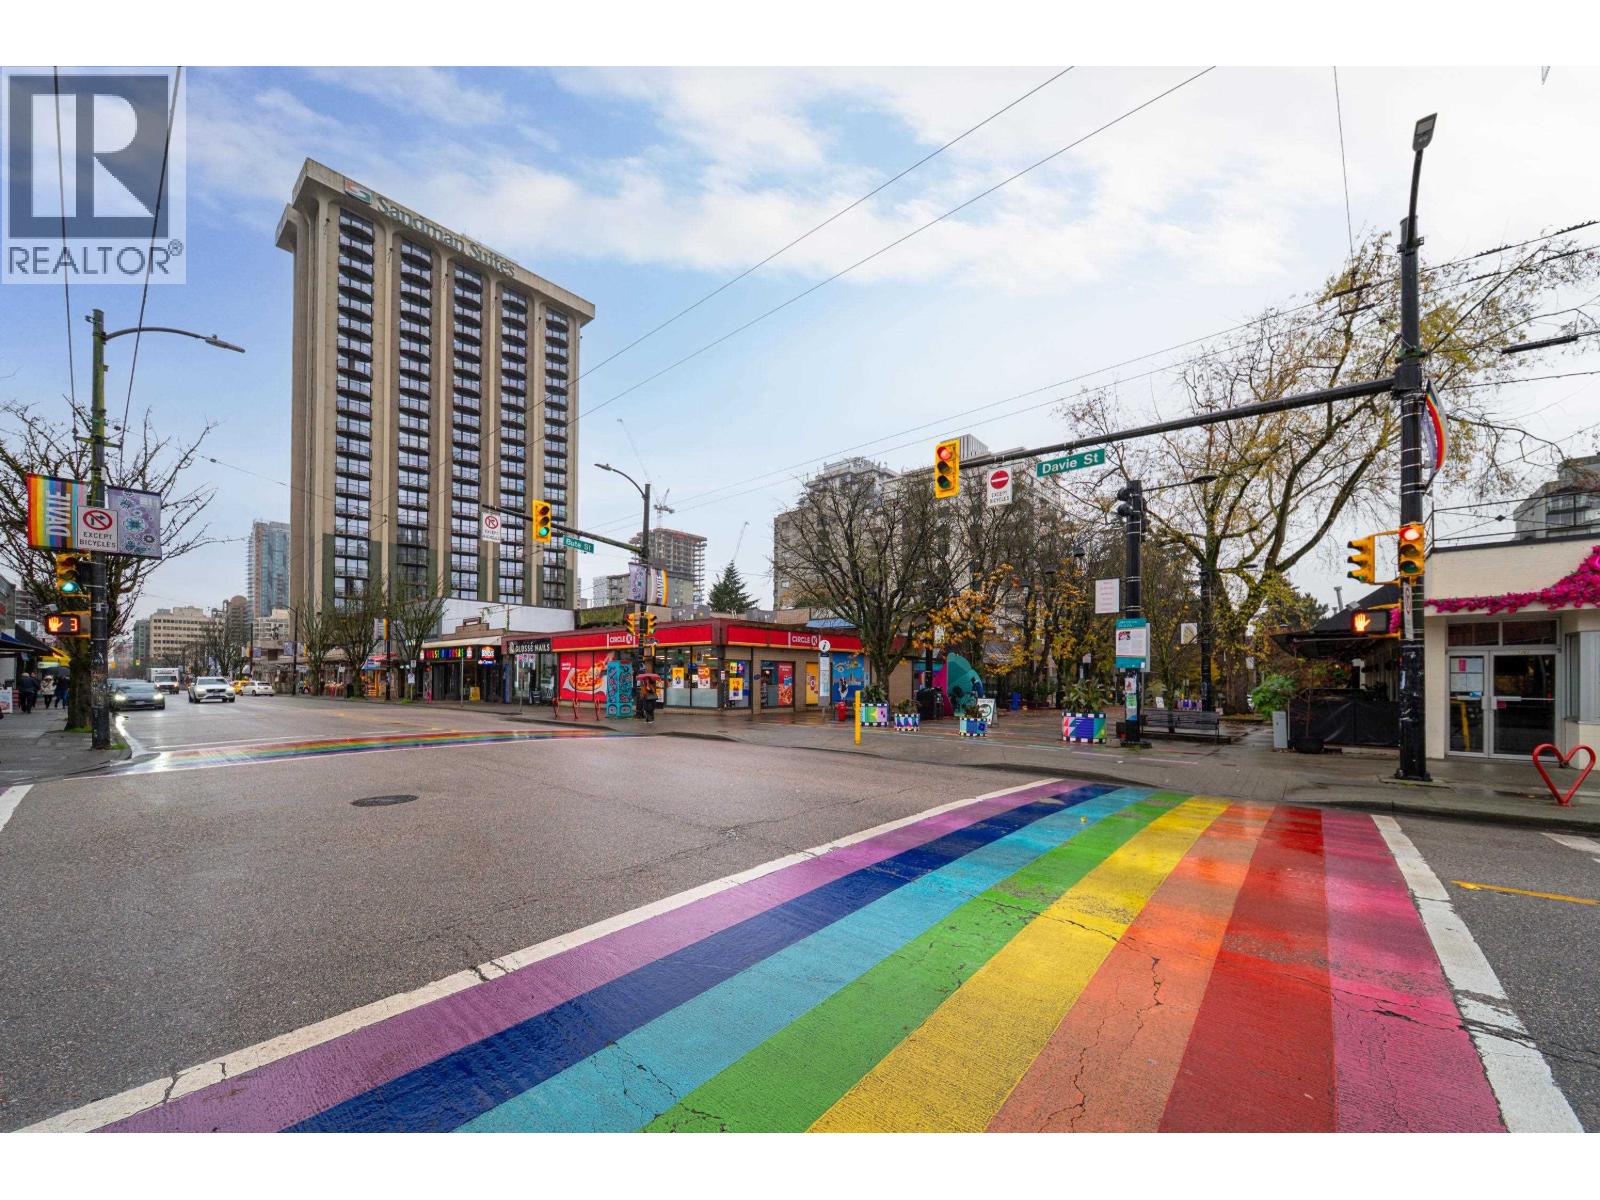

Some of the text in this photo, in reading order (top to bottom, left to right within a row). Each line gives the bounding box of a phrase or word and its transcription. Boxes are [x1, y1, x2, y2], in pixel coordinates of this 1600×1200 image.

[377, 196, 515, 278] Sandman Suites
[1042, 453, 1098, 474] Davie St
[83, 531, 112, 540] EXCEPT
[79, 538, 116, 548] BICYCLES
[566, 538, 592, 552] Bute St
[70, 618, 77, 631] 3
[610, 635, 625, 643] CIRCLE
[792, 636, 810, 644] CIRCLE
[535, 643, 550, 652] NAILS
